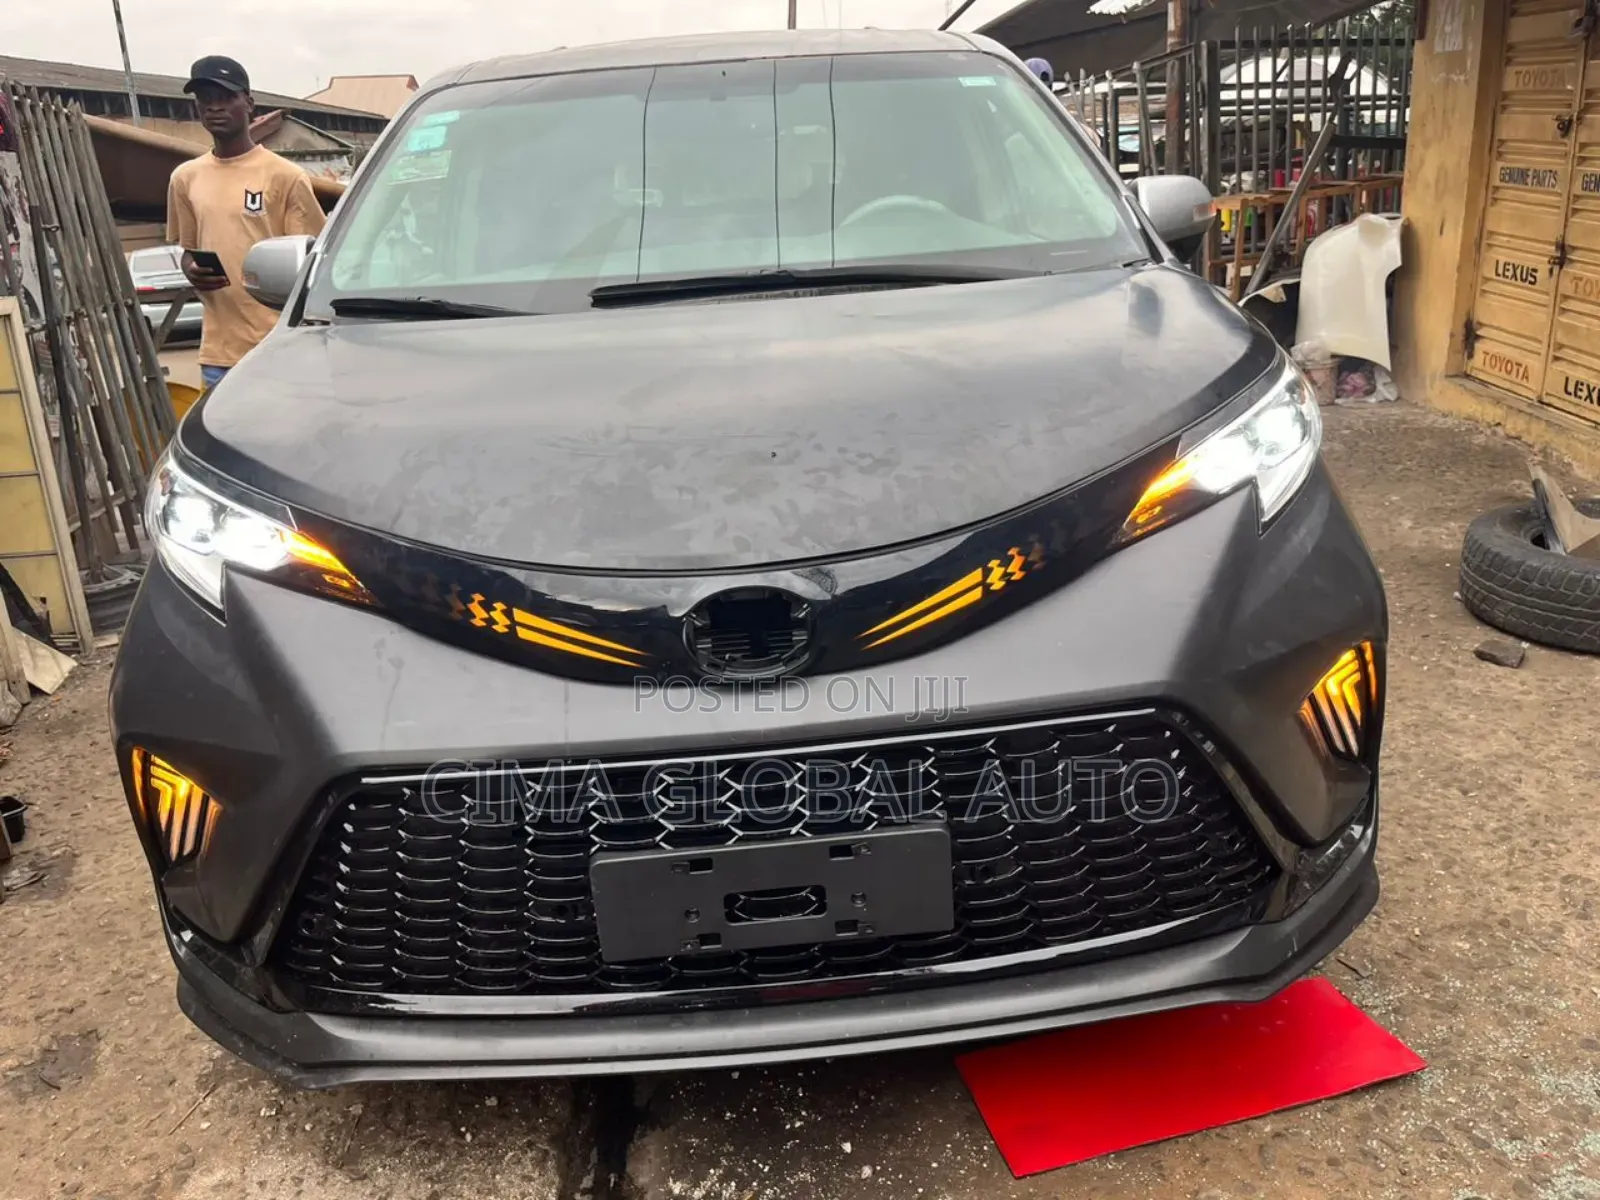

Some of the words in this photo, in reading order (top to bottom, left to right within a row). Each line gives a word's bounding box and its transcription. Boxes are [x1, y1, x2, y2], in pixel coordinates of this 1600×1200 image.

[1514, 68, 1567, 88] TOYOTA
[1499, 166, 1530, 186] GENUINE
[1531, 168, 1558, 189] PARTS
[1494, 259, 1539, 286] LEXUS
[1481, 351, 1530, 383] TOYOTA
